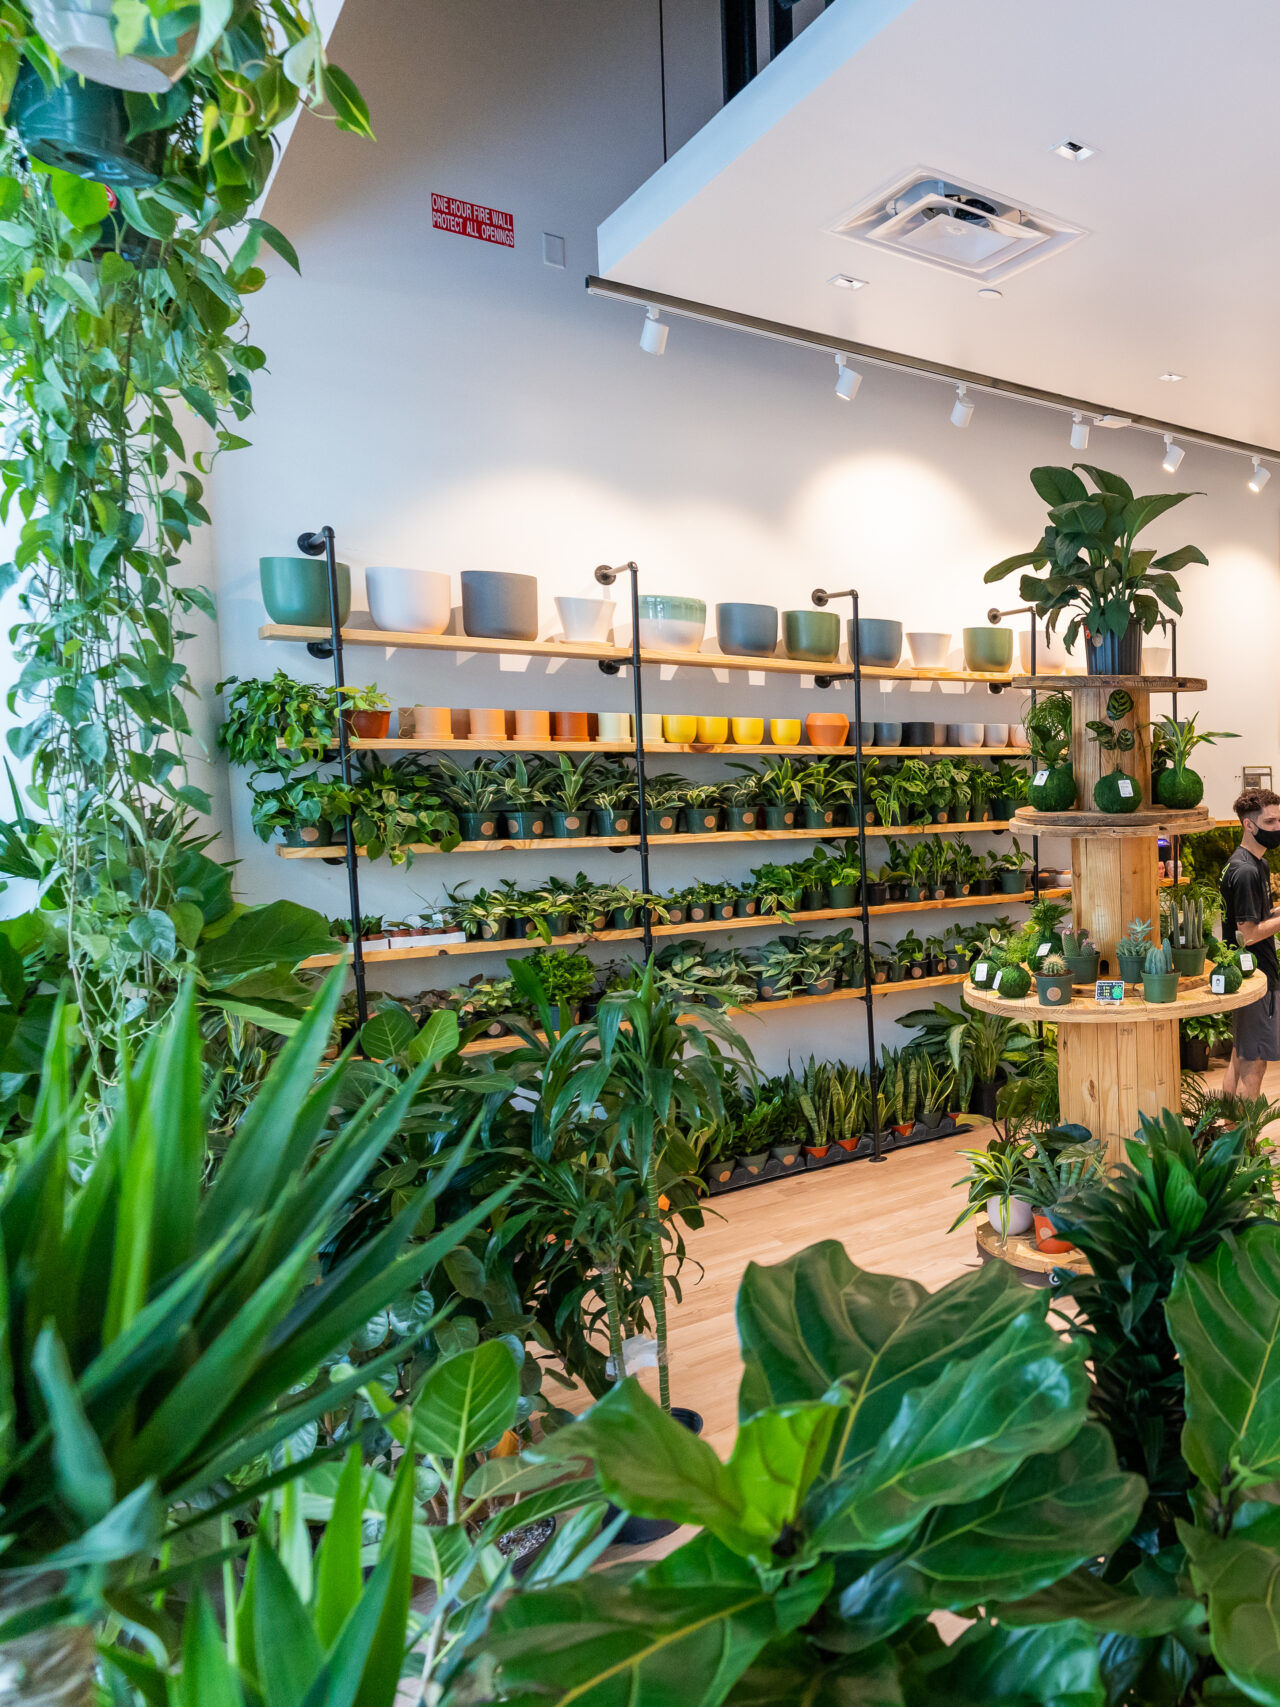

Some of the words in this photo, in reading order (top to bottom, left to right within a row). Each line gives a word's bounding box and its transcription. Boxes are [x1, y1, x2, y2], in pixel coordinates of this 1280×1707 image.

[432, 195, 448, 213] ONE
[450, 199, 472, 218] HOUR
[473, 206, 490, 223] FIRE
[491, 209, 512, 229] WALL
[432, 211, 463, 233] PROTECT
[466, 220, 479, 237] ALL
[481, 224, 514, 246] OPENINGS
